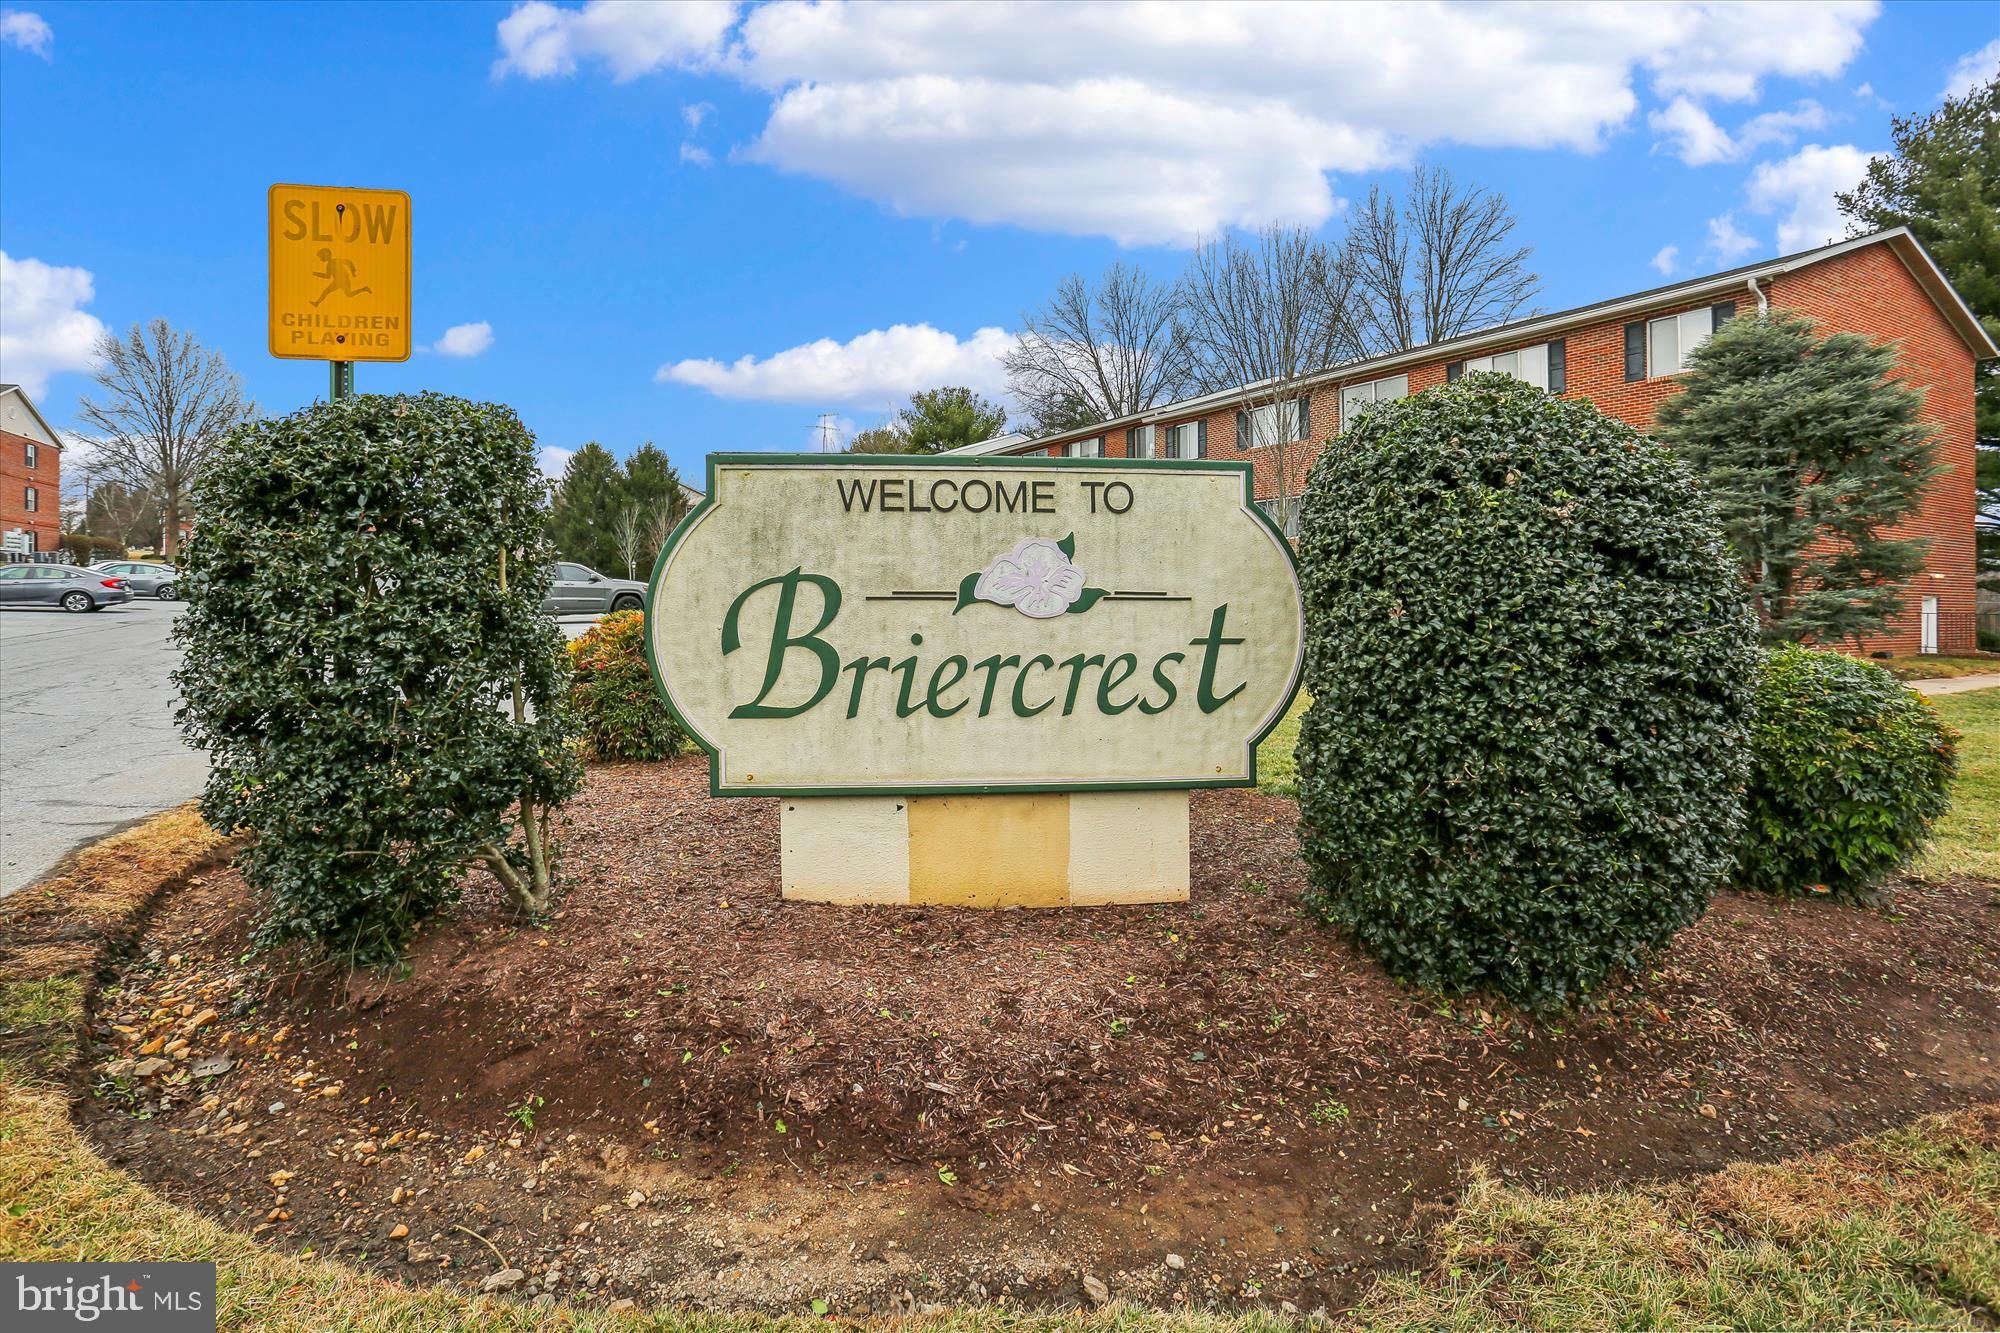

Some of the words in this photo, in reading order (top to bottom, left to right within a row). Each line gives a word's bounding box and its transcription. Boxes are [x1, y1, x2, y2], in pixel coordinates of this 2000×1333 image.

[283, 199, 397, 244] SLOW
[281, 312, 399, 330] CHILDREN
[837, 479, 1056, 513] WELCOME
[1082, 481, 1135, 514] TO
[720, 566, 1247, 719] Briercrest
